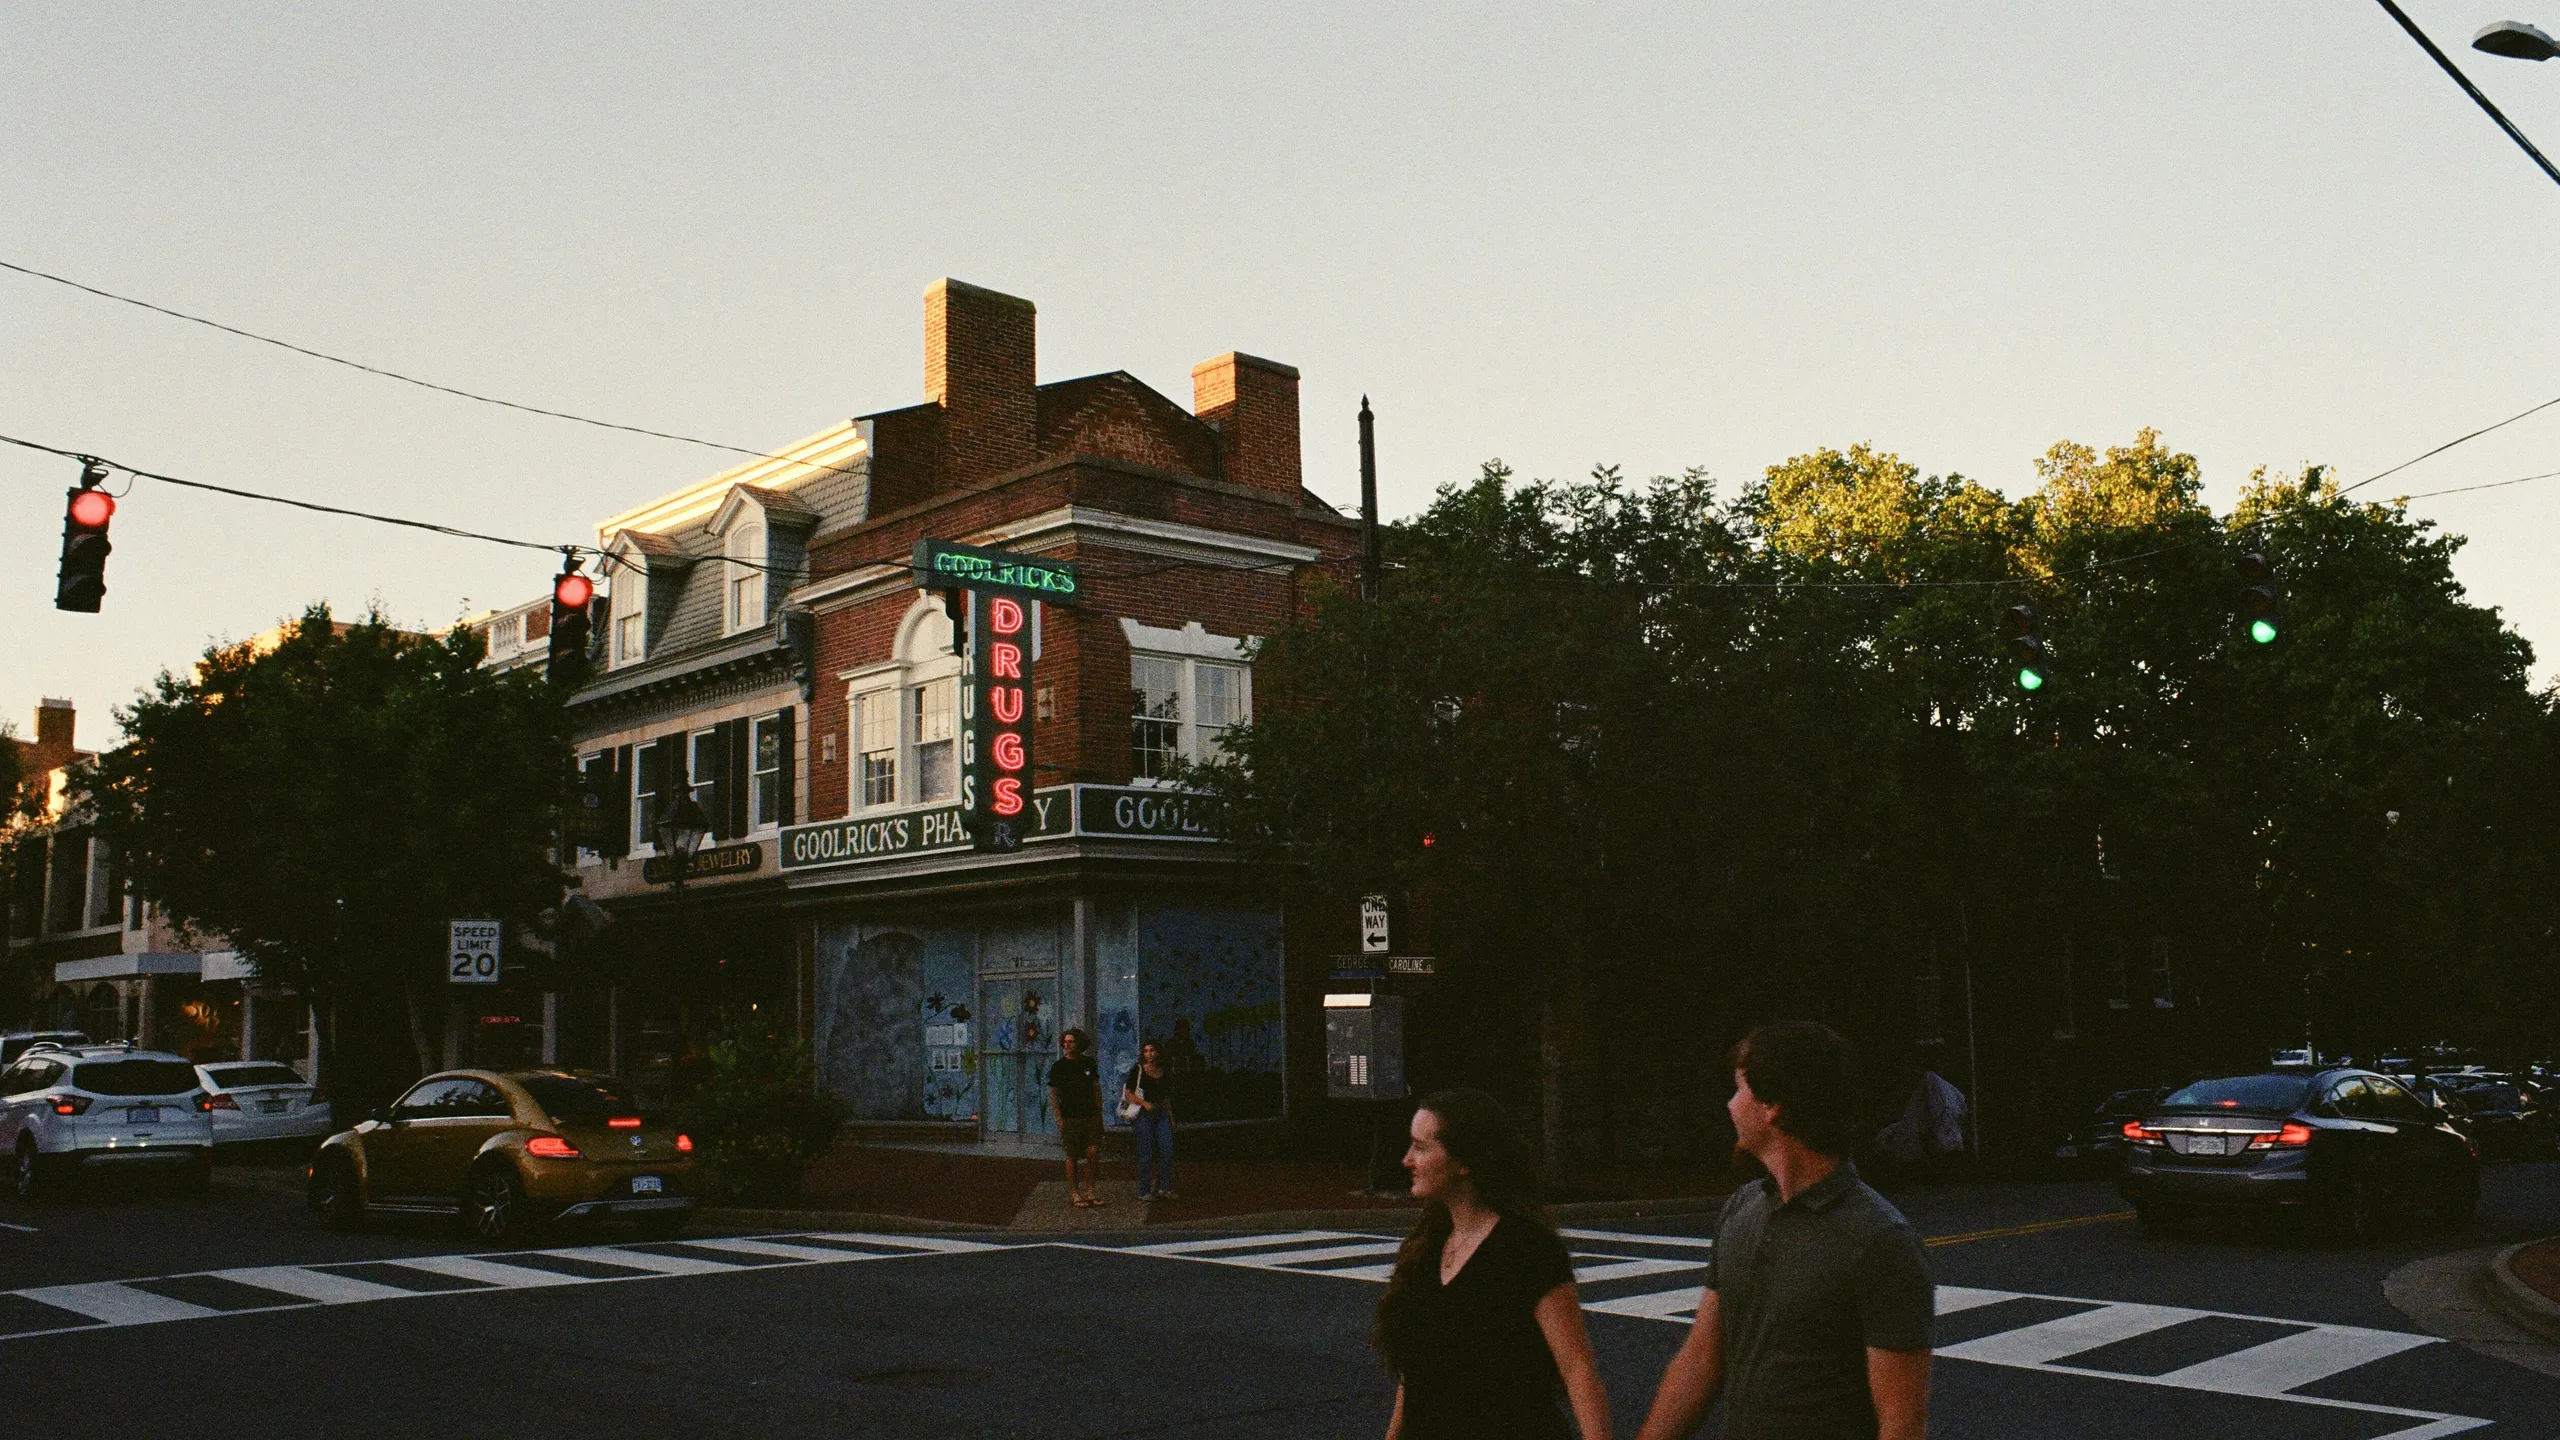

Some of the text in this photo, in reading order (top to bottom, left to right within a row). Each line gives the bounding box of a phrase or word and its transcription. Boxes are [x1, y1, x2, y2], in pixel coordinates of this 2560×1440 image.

[935, 552, 1075, 593] GOOLRICK'S
[991, 598, 1024, 815] DRUGS
[794, 797, 1052, 861] GOOLRICK'S PHAY
[696, 848, 754, 871] JEWELRY
[454, 927, 497, 937] SPEED
[1365, 915, 1385, 929] WAY
[457, 940, 491, 950] LIMIT
[453, 953, 495, 976] 20
[1388, 959, 1424, 971] CAROLINE
